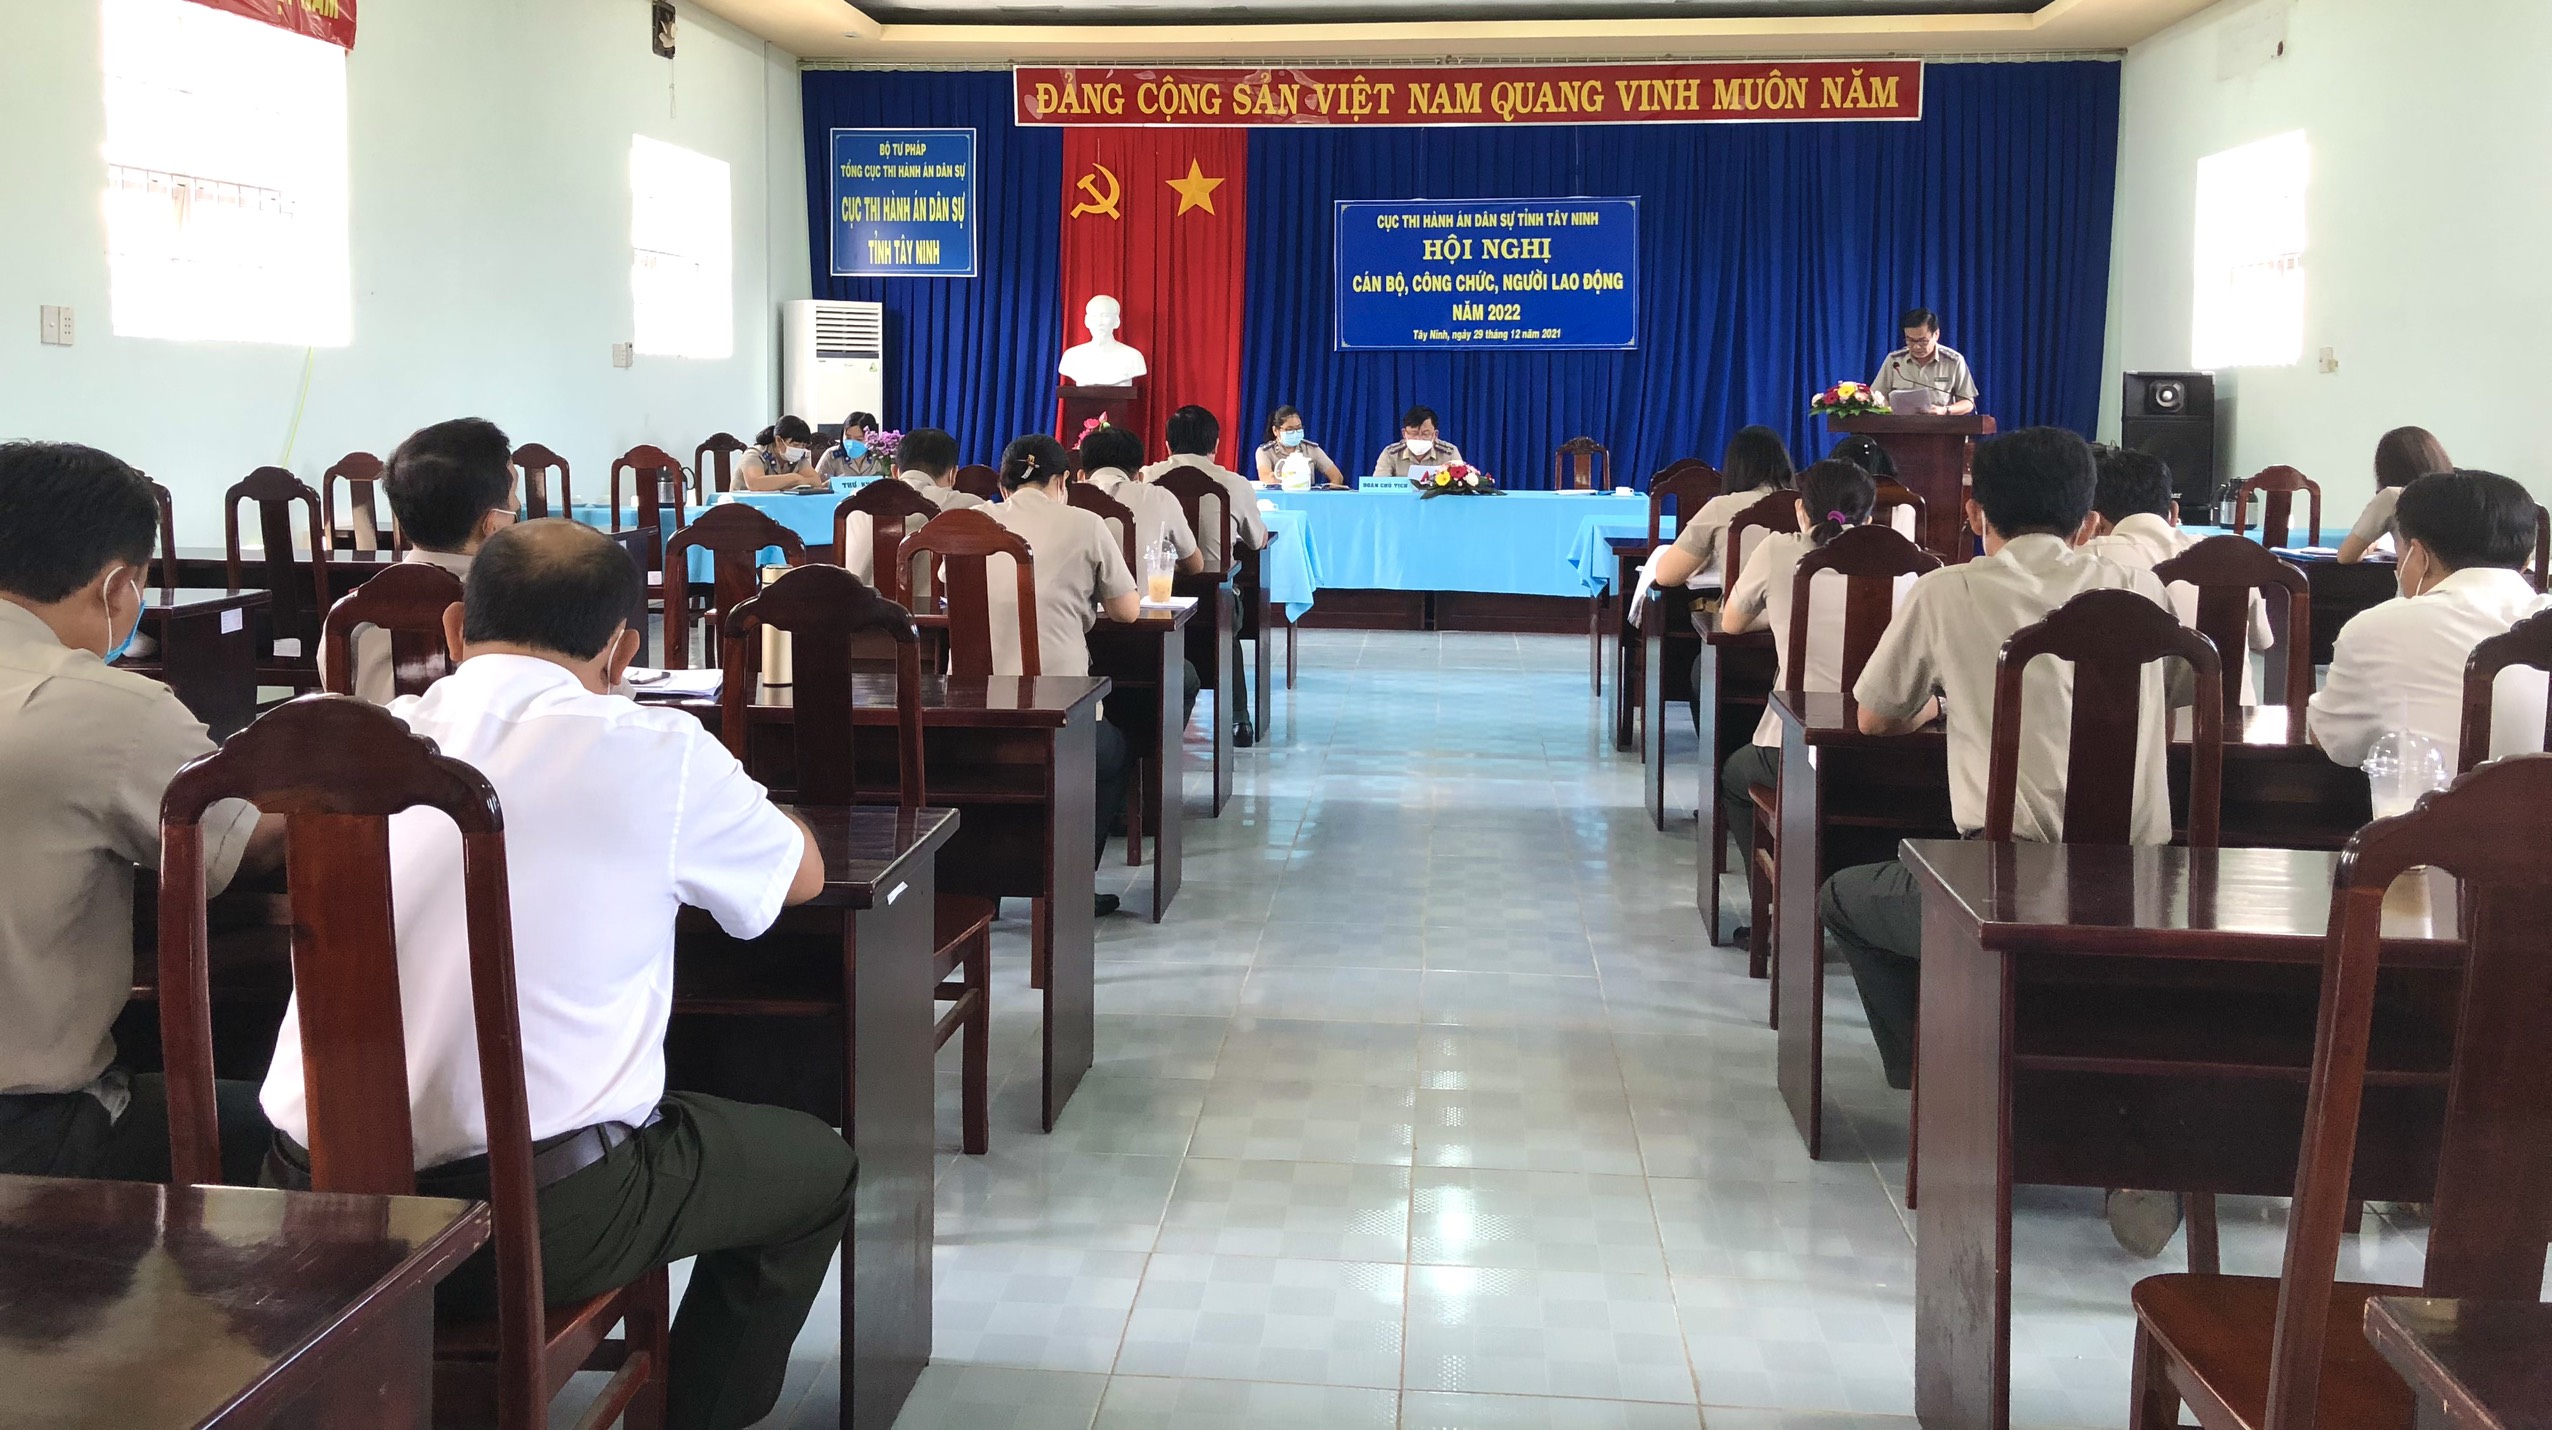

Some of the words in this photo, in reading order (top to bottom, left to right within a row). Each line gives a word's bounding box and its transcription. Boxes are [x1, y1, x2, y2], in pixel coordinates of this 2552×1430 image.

[1036, 73, 1125, 114] ĐẢNG
[1137, 75, 1222, 121] CỘNG
[1232, 72, 1299, 114] SẢN
[1314, 75, 1395, 121] VIỆT
[1408, 82, 1482, 113] NAM
[1490, 80, 1604, 121] QUANG
[1616, 79, 1700, 111] VINH
[1712, 69, 1808, 110] MUÔN
[1821, 68, 1899, 108] NĂM
[879, 141, 891, 159] BỘ
[892, 141, 904, 156] TƯ
[905, 140, 926, 156] PHÁP
[841, 159, 863, 178] TỔNG
[865, 165, 881, 181] CỤC
[883, 165, 897, 177] THI
[899, 162, 921, 177] HÀNH
[923, 162, 934, 177] ÁN
[936, 162, 953, 177] DÂN
[955, 163, 966, 181] SỰ
[842, 197, 862, 229] CỤC
[864, 197, 881, 221] THI
[883, 190, 911, 222] HÀNH
[913, 190, 927, 222] ÁN
[929, 191, 950, 222] DÂN
[952, 191, 966, 229] SỰ
[1377, 214, 1399, 232] CỤC
[1402, 214, 1420, 228] THI
[1423, 211, 1454, 228] HÀNH
[1456, 210, 1472, 228] ÁN
[1475, 211, 1498, 227] DÂN
[1500, 212, 1515, 230] SỰ
[1518, 208, 1544, 227] TỈNH
[1547, 209, 1569, 226] TÂY
[1571, 212, 1599, 225] NINH
[868, 230, 892, 265] TỈNH
[894, 234, 914, 265] TÂY
[916, 240, 940, 265] NINH
[1423, 233, 1473, 264] HỘI
[1481, 238, 1552, 264] NGHỊ
[1353, 271, 1382, 292] CÁN
[1386, 272, 1409, 297] BỘ,
[1412, 271, 1452, 291] CÔNG
[1455, 270, 1499, 294] CHỨC,
[1503, 269, 1548, 291] NGƯỜI
[1552, 273, 1579, 290] LAO
[1583, 269, 1624, 295] ĐỘNG
[1453, 301, 1484, 321] NĂM
[1488, 304, 1521, 320] 2022
[1413, 329, 1427, 341] Tây
[1430, 329, 1450, 341] Ninh,
[1452, 330, 1471, 341] ngày
[1473, 330, 1484, 339] 29
[1485, 328, 1508, 341] tháng
[1510, 329, 1521, 339] 12
[1522, 329, 1540, 338] năm
[1542, 329, 1561, 338] 2021
